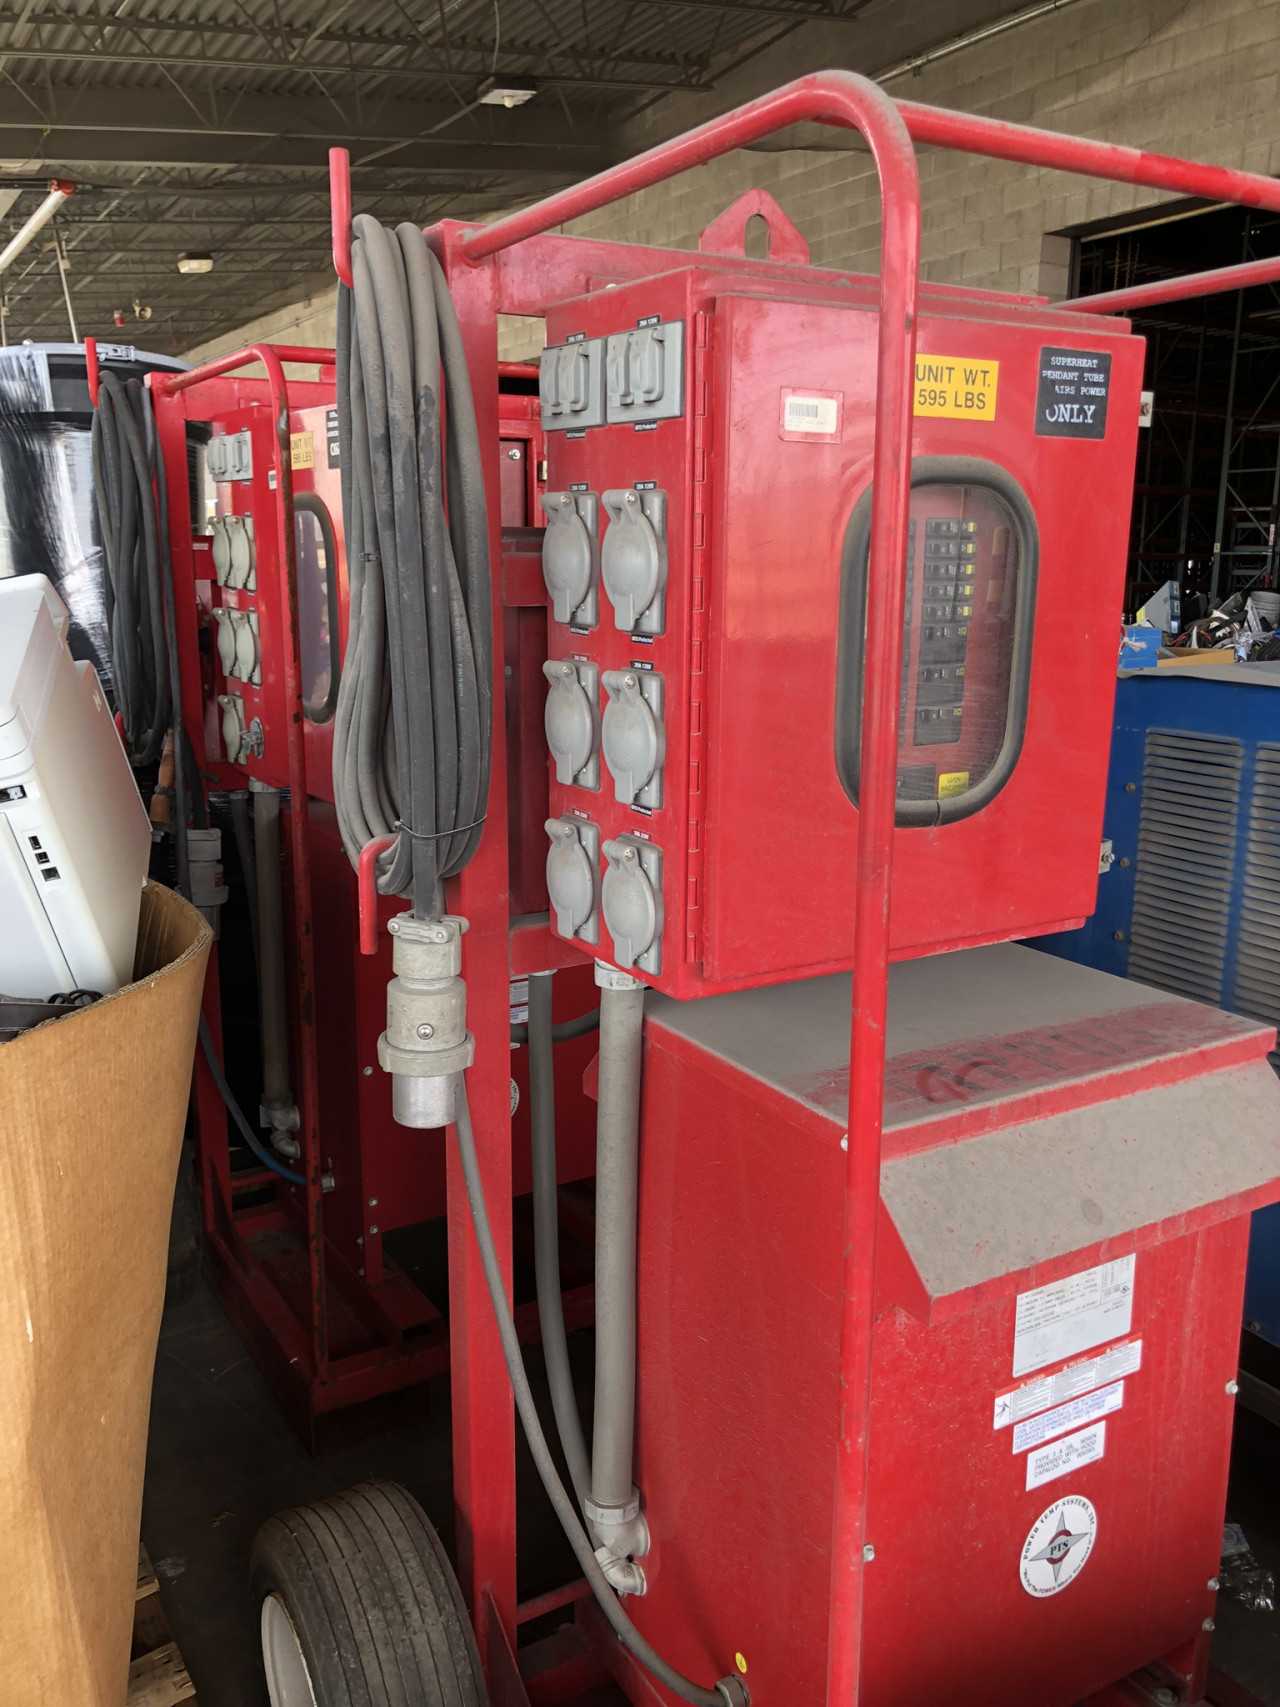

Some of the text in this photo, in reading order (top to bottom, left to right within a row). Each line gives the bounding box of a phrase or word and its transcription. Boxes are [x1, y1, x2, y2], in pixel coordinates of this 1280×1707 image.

[1050, 356, 1098, 368] SUPERHEAT
[915, 363, 991, 388] UNIT WT.
[1083, 373, 1105, 383] TUBE
[918, 388, 986, 410] 595 LBS
[1080, 386, 1106, 397] POWER
[1045, 403, 1096, 423] ONLY
[1023, 1527, 1039, 1560] POWER
[1040, 1504, 1060, 1524] TEMP
